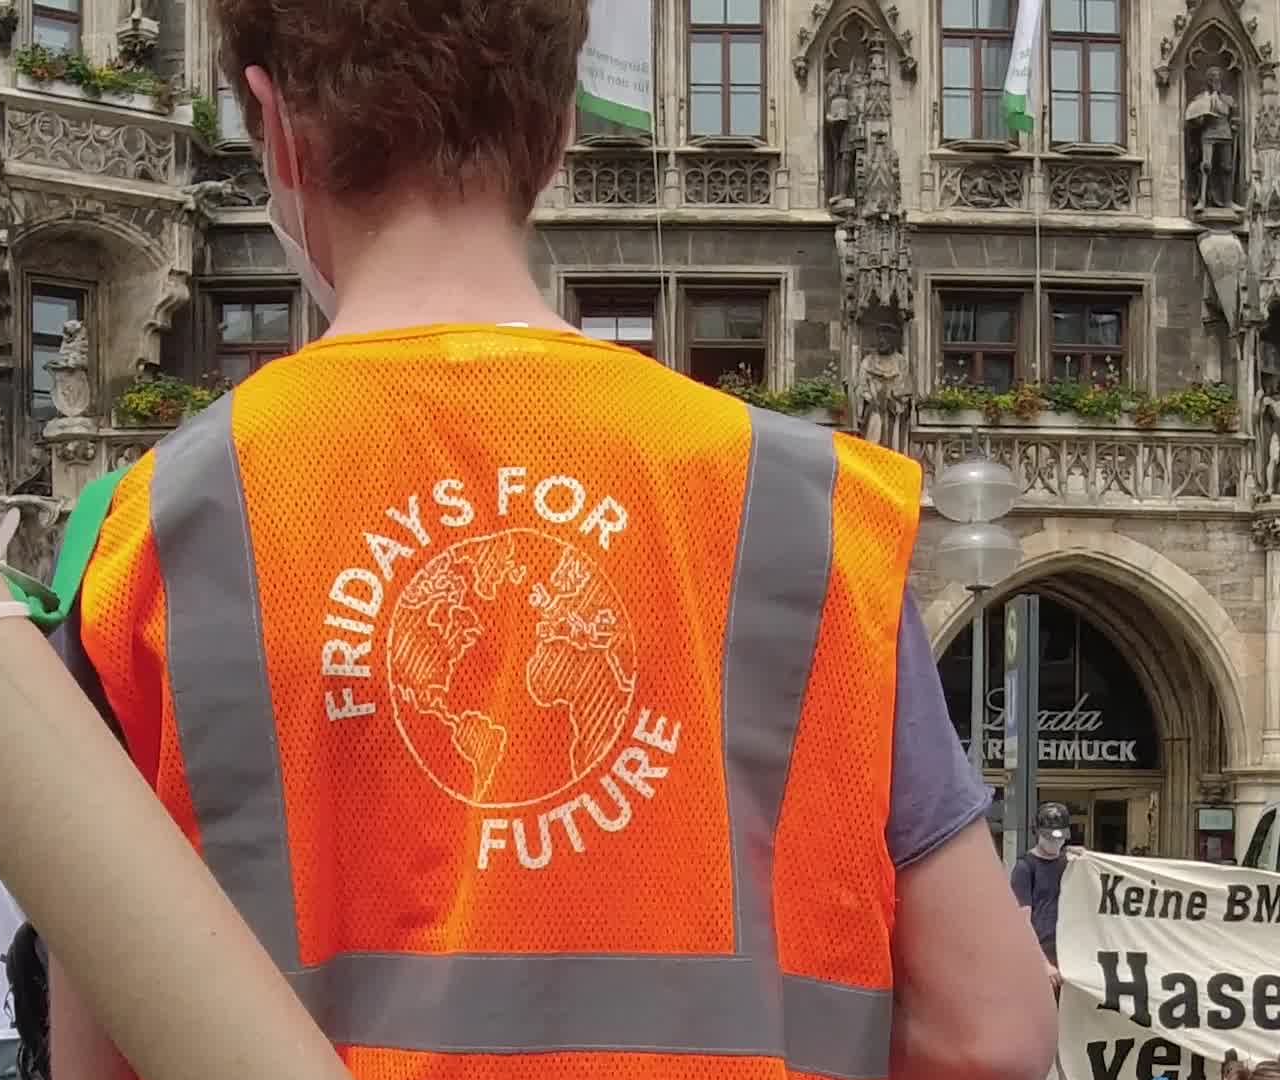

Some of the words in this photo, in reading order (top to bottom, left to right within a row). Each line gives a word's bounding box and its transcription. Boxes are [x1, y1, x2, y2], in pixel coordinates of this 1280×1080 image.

[321, 479, 475, 722] FRIDAYS
[497, 467, 629, 549] FOR
[477, 708, 682, 869] FUTURE
[1098, 873, 1207, 921] Keine
